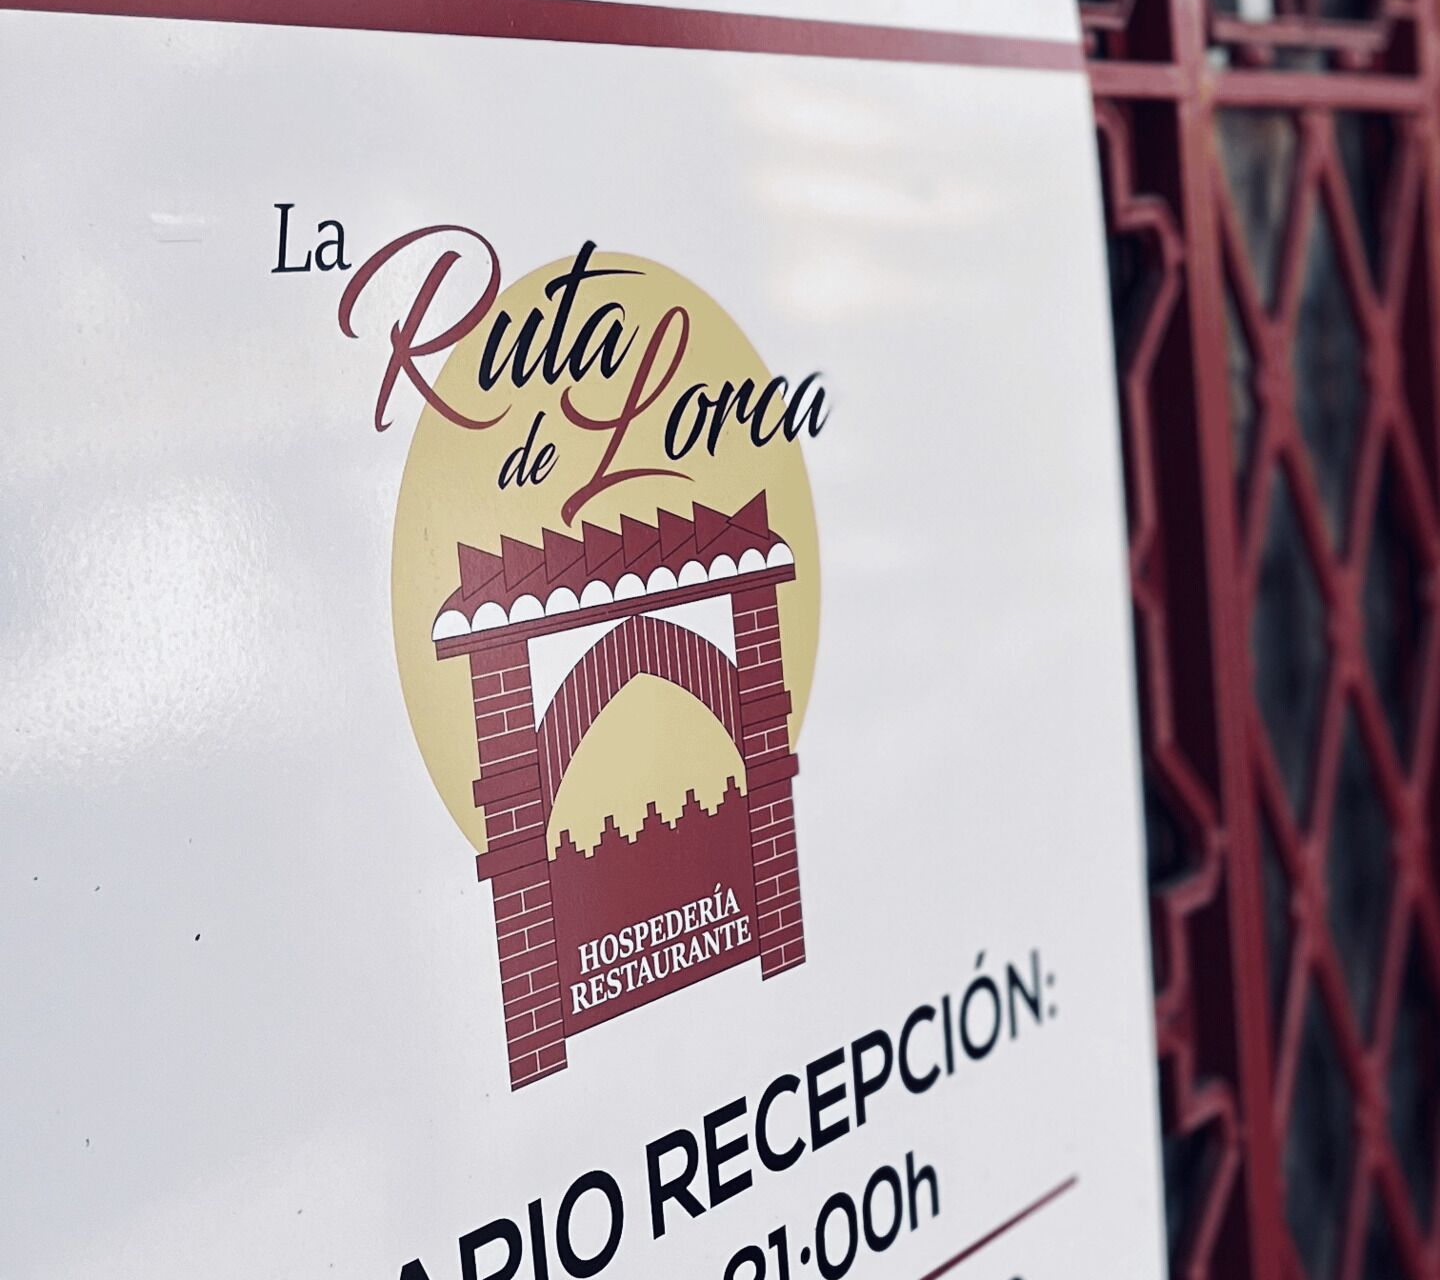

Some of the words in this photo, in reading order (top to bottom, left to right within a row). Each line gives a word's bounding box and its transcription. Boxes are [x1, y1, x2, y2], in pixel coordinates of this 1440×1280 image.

[272, 202, 352, 274] La
[338, 224, 647, 433] Ruta
[498, 411, 561, 490] de
[560, 306, 833, 528] Lorca
[569, 915, 752, 1015] RESTAURANTE
[577, 882, 741, 975] HOSPEDERÍA
[645, 949, 1057, 1241] RECEPCIÓN:
